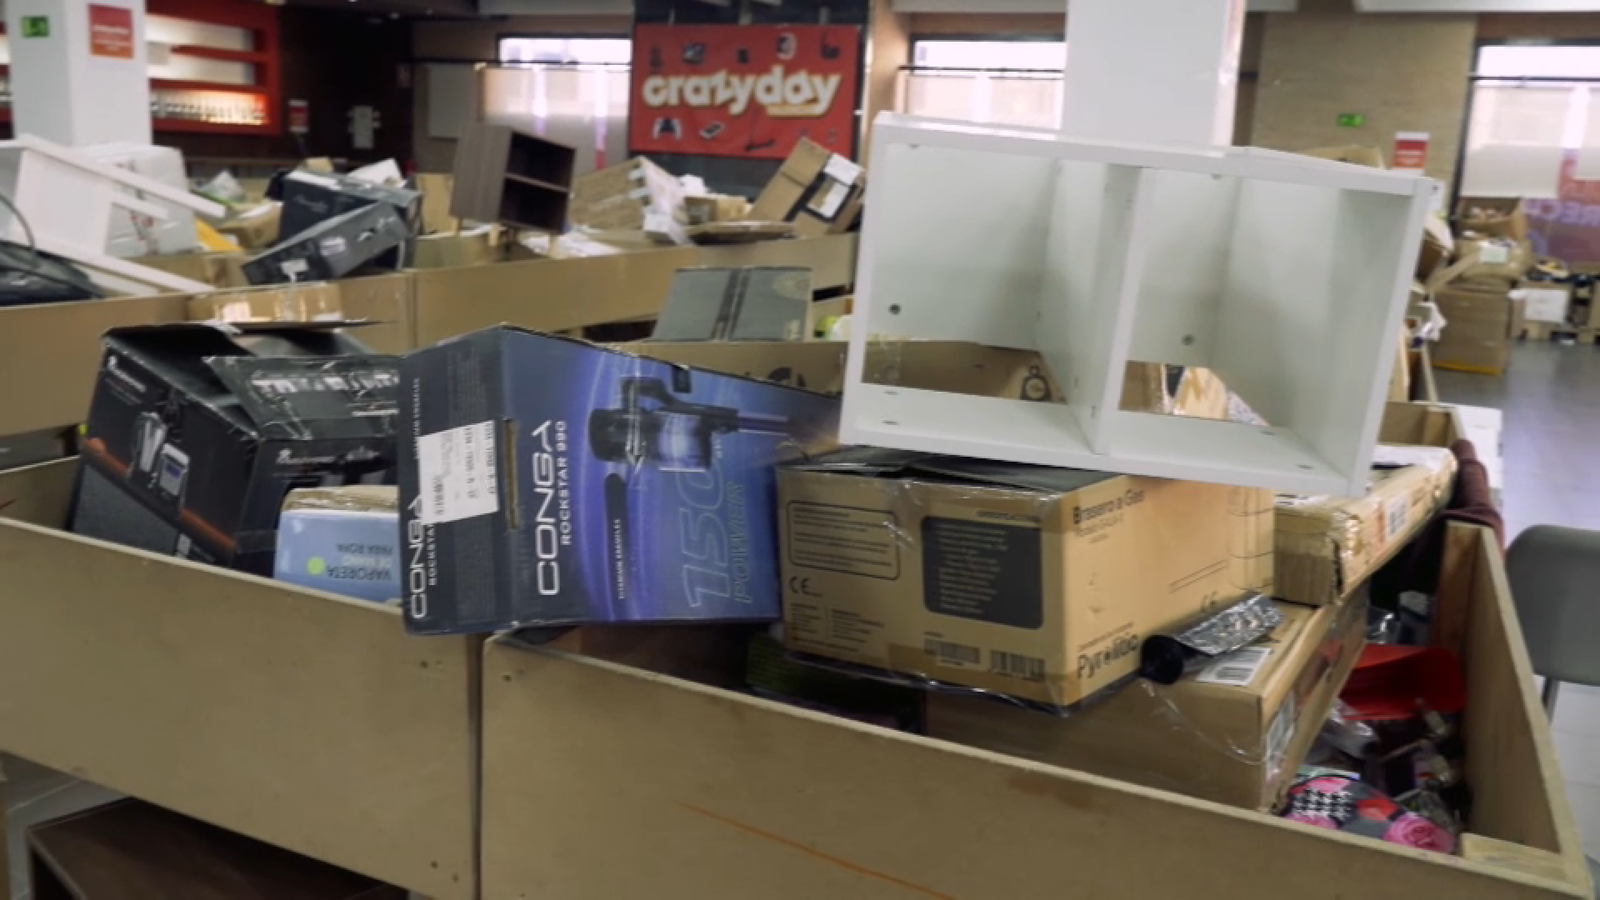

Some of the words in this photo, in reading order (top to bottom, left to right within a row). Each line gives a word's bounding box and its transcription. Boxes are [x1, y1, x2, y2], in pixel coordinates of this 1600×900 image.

[554, 420, 568, 453] 990
[530, 419, 561, 596] CONGA
[556, 456, 572, 546] ROCKSTAR
[726, 481, 753, 604] POWER
